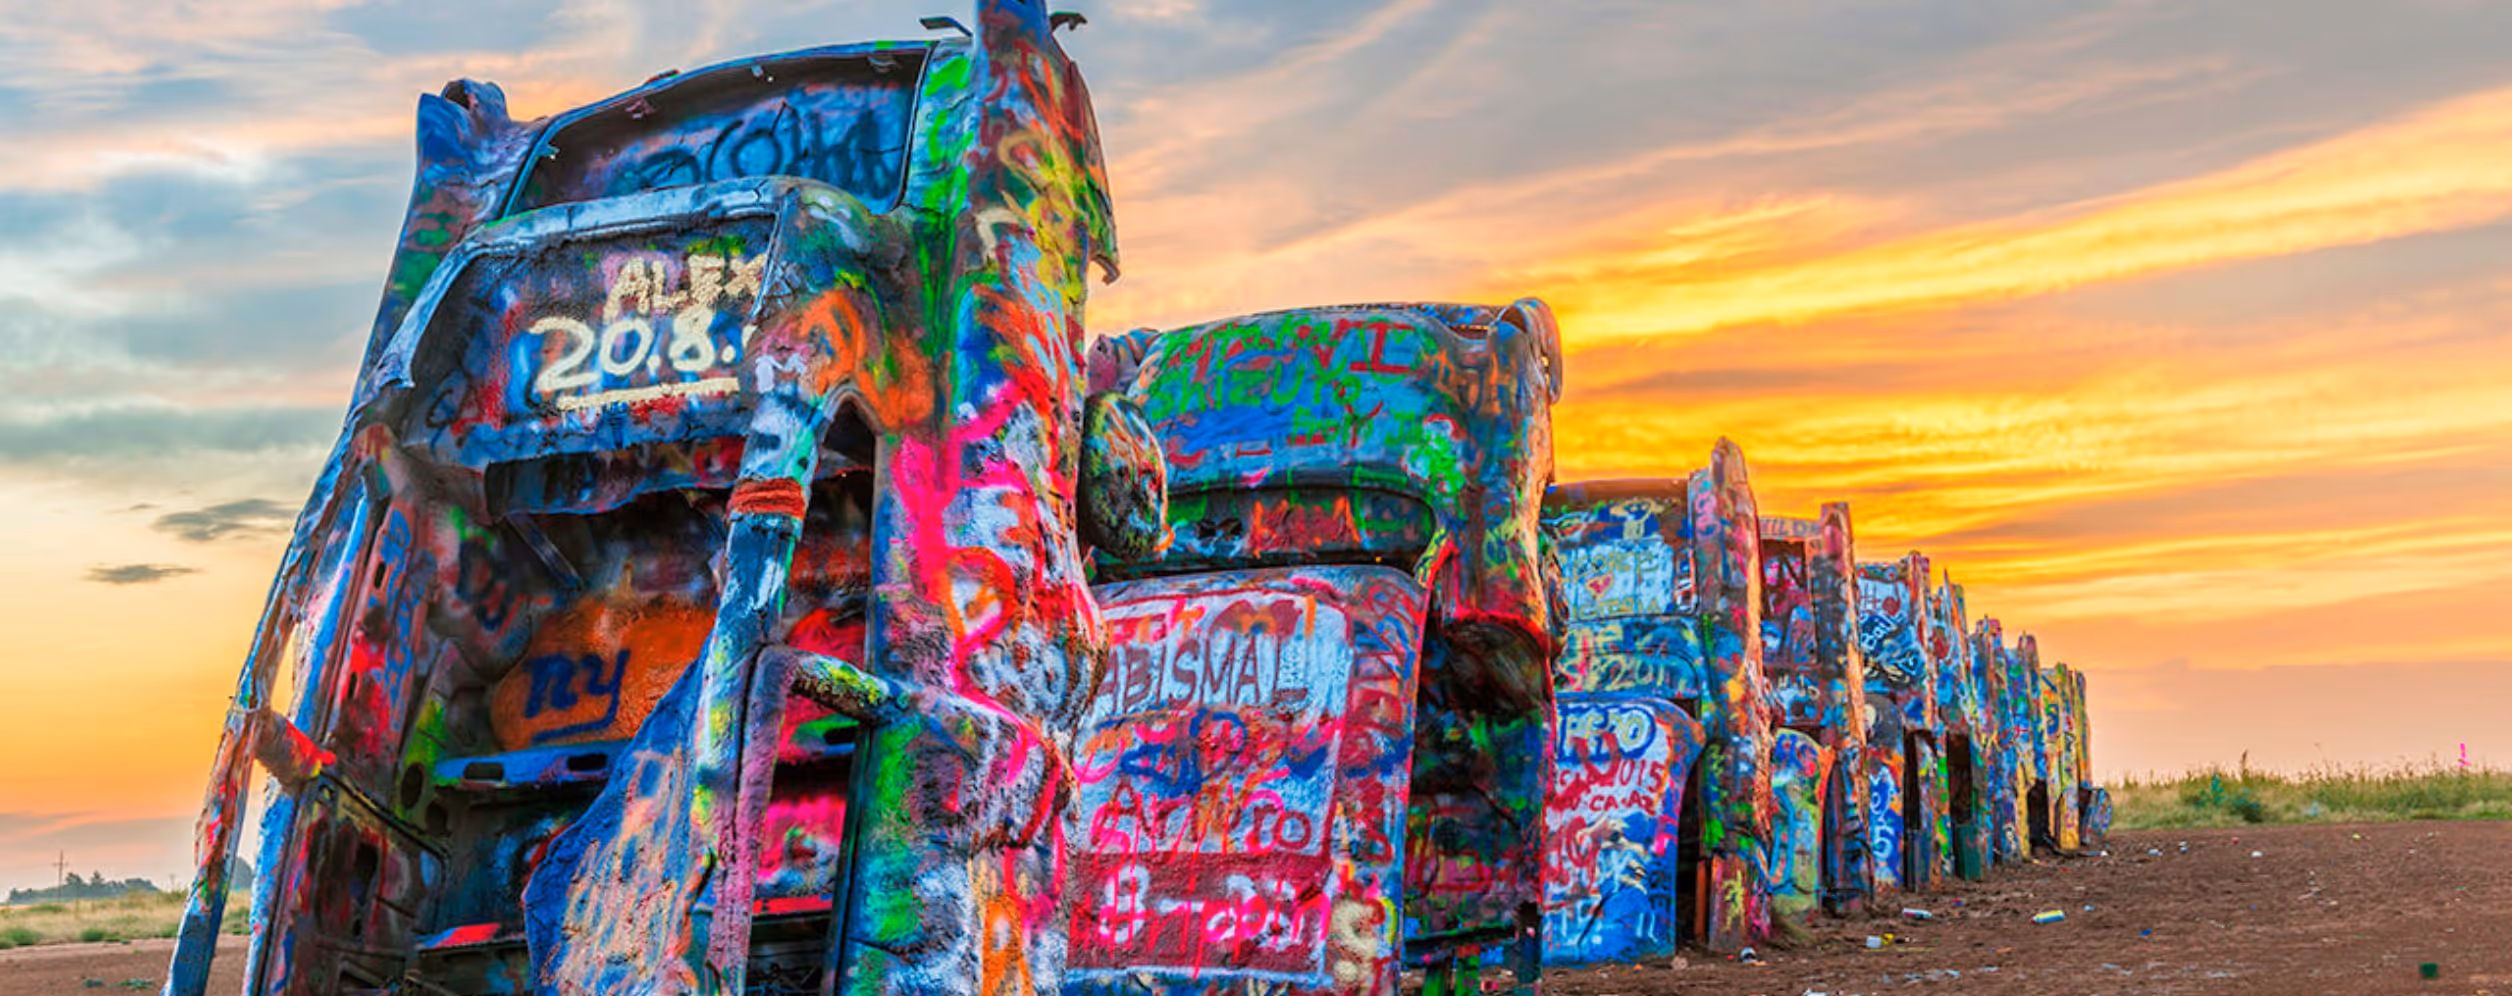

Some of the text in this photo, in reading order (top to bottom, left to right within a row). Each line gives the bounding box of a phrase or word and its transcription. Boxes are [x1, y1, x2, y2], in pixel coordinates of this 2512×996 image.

[603, 253, 768, 324] ALEX
[528, 314, 757, 393] 20.8.
[1098, 637, 1314, 714] ABISMAL
